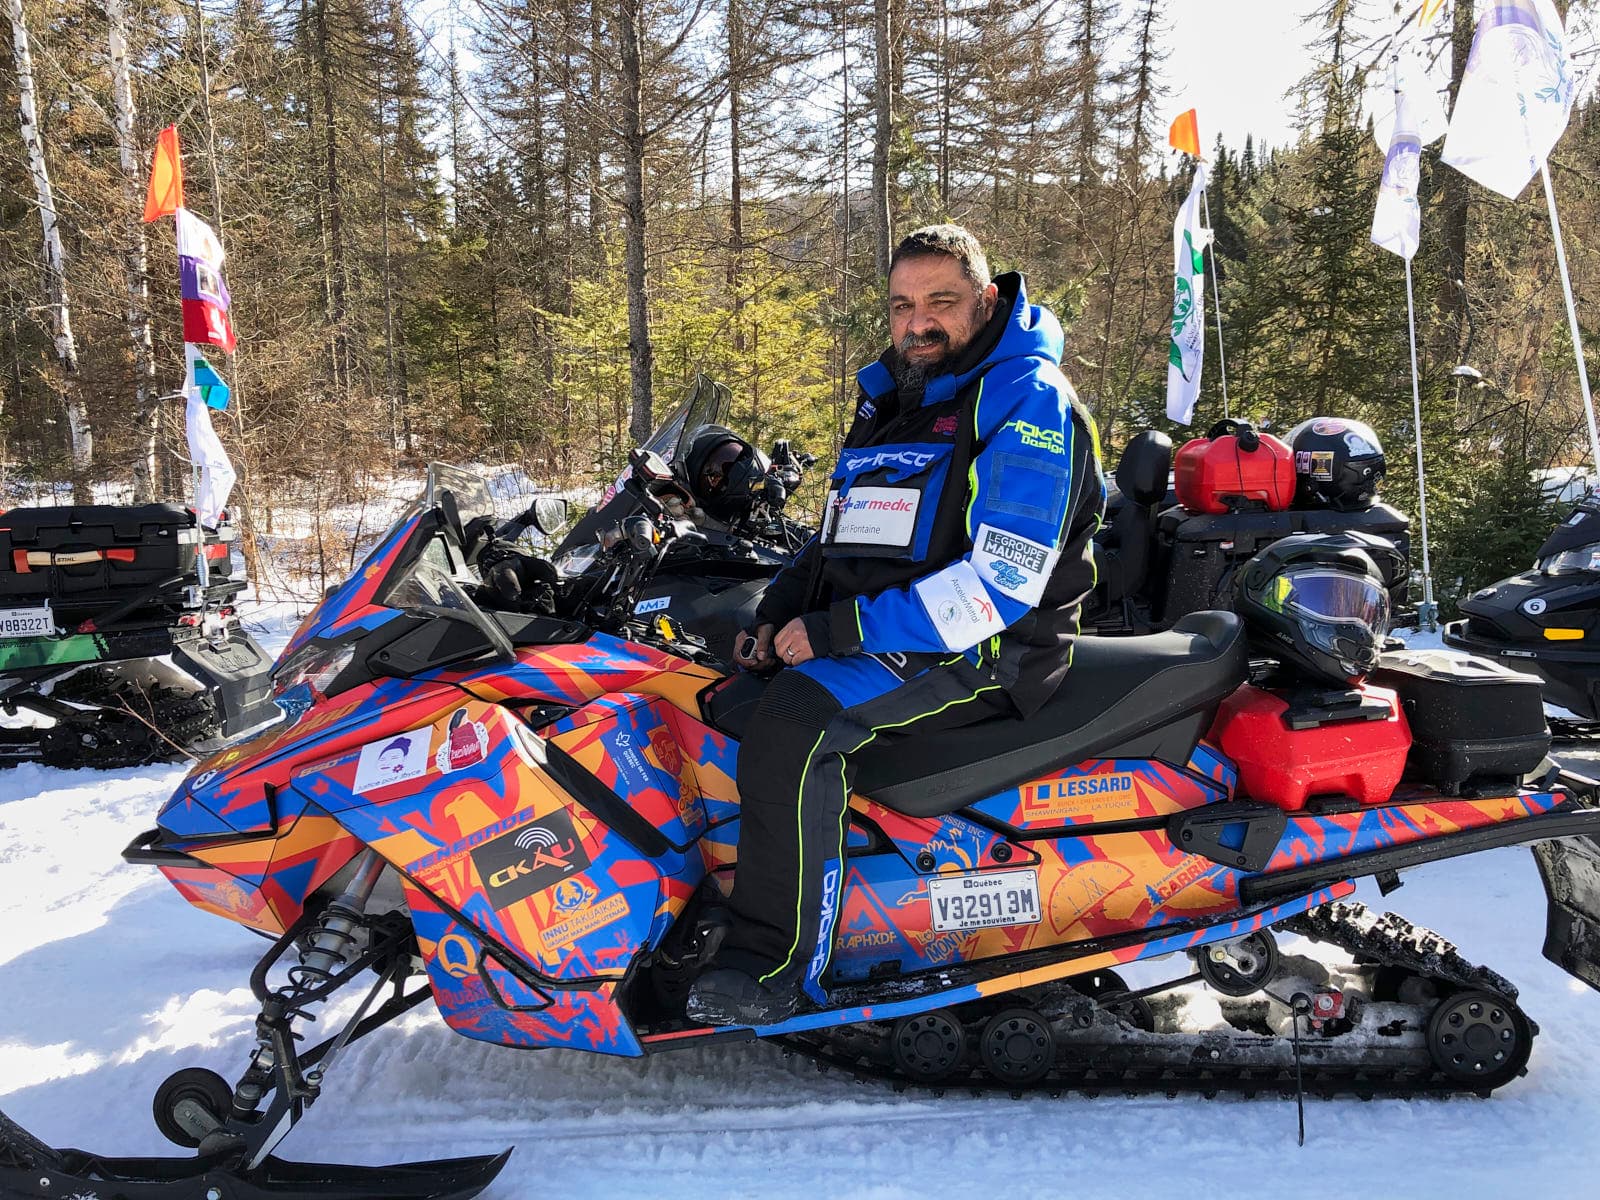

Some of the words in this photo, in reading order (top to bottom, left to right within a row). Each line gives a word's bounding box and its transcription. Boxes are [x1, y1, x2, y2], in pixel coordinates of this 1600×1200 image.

[850, 524, 880, 535] Fontaine
[985, 541, 1041, 571] MAURICE
[951, 579, 980, 624] ArcelorMittal
[1529, 601, 1540, 612] 6
[1058, 776, 1132, 797] LESSARD
[1026, 806, 1080, 817] SHAWINIGAN
[1105, 800, 1132, 809] TUQUE
[405, 807, 535, 872] RENEGADE
[973, 880, 1003, 888] Québec
[937, 889, 1034, 921] V32913M
[983, 916, 1016, 925] souviens
[542, 924, 569, 941] INNU
